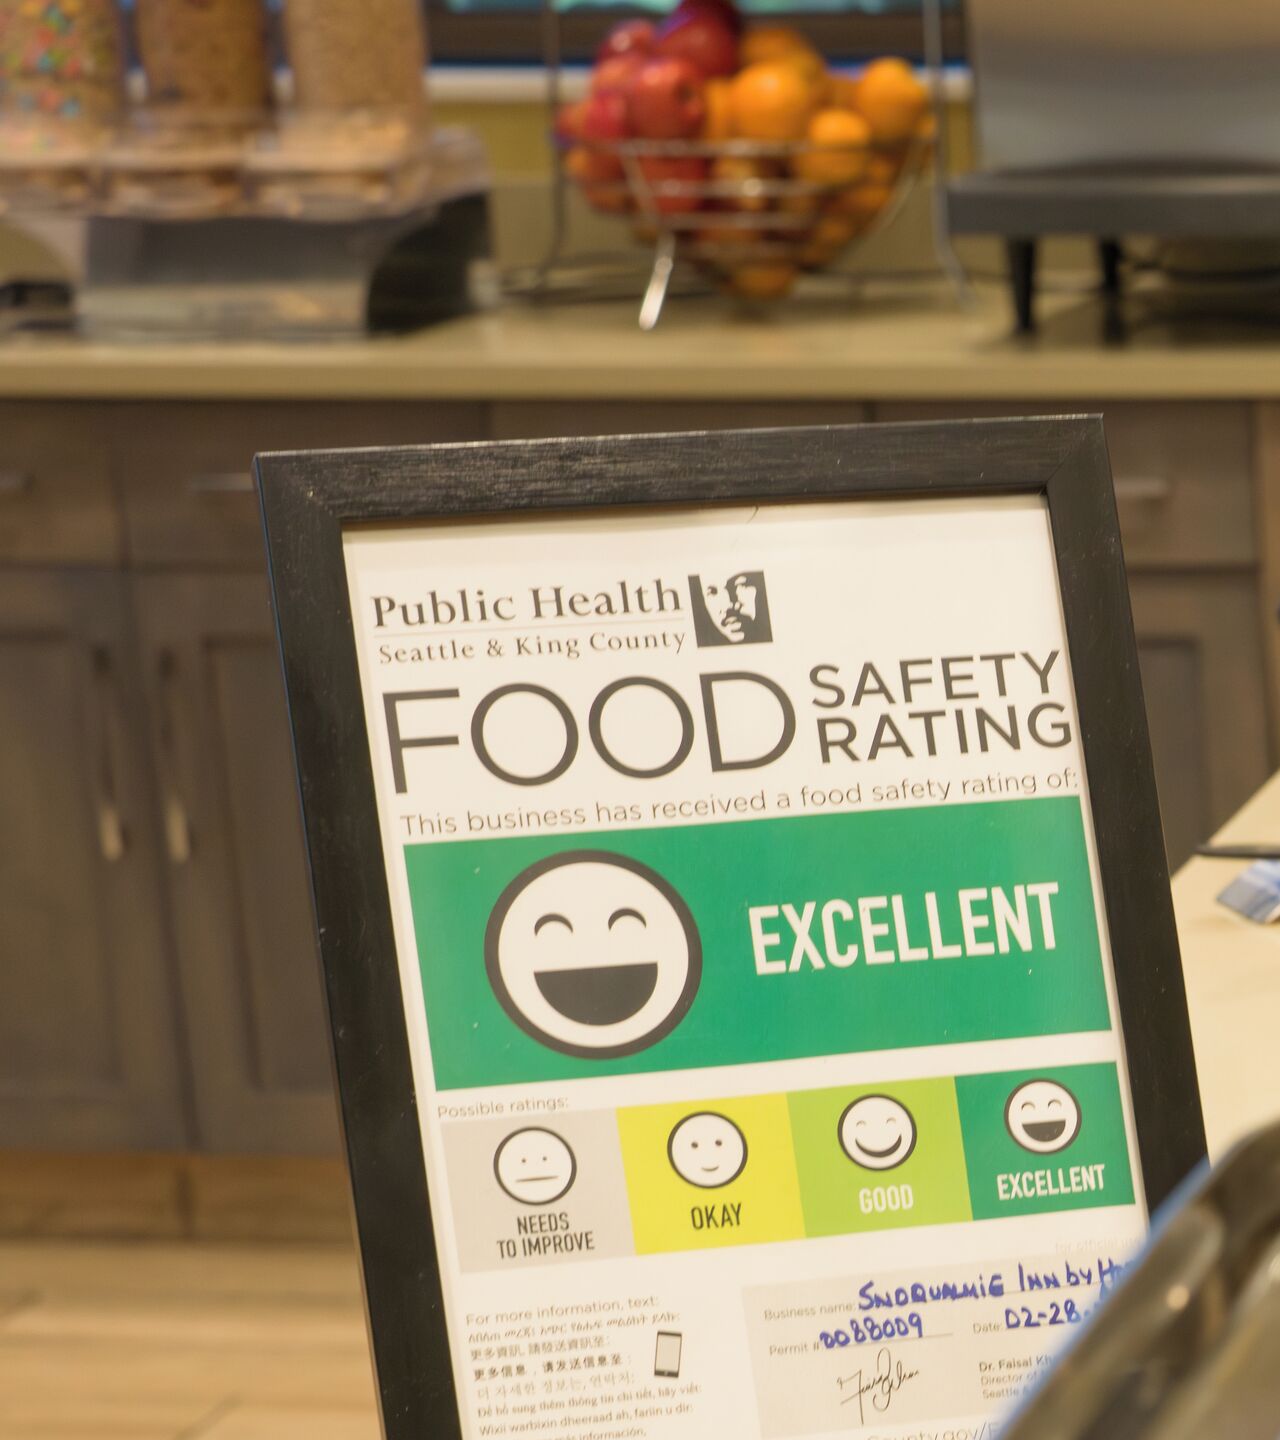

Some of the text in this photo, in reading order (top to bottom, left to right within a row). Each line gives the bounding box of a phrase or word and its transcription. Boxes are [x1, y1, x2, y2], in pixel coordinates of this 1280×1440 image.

[370, 577, 683, 628] Public Health
[379, 630, 686, 665] Seattle & King County
[809, 649, 1060, 709] SAFETY
[382, 670, 797, 795] FOOD
[816, 702, 1073, 764] RATING
[401, 767, 1079, 837] This business has received a food safety rating of:
[748, 880, 1060, 977] EXCELLENT
[437, 1095, 569, 1119] Possible ratings:
[996, 1164, 1105, 1201] EXCELLENT
[858, 1184, 914, 1215] GOOD
[517, 1211, 570, 1235] NEEDS
[690, 1202, 742, 1230] OKAY
[496, 1231, 595, 1259] TO IMPROVE
[465, 1295, 659, 1327] For more information, text:
[764, 1301, 857, 1321] Business name:
[1004, 1299, 1095, 1329] 02-28-
[769, 1341, 809, 1357] Permit
[979, 1361, 995, 1374] Dr.
[998, 1357, 1033, 1371] Faisal
[980, 1373, 1023, 1386] Director
[982, 1386, 1020, 1400] Seattle
